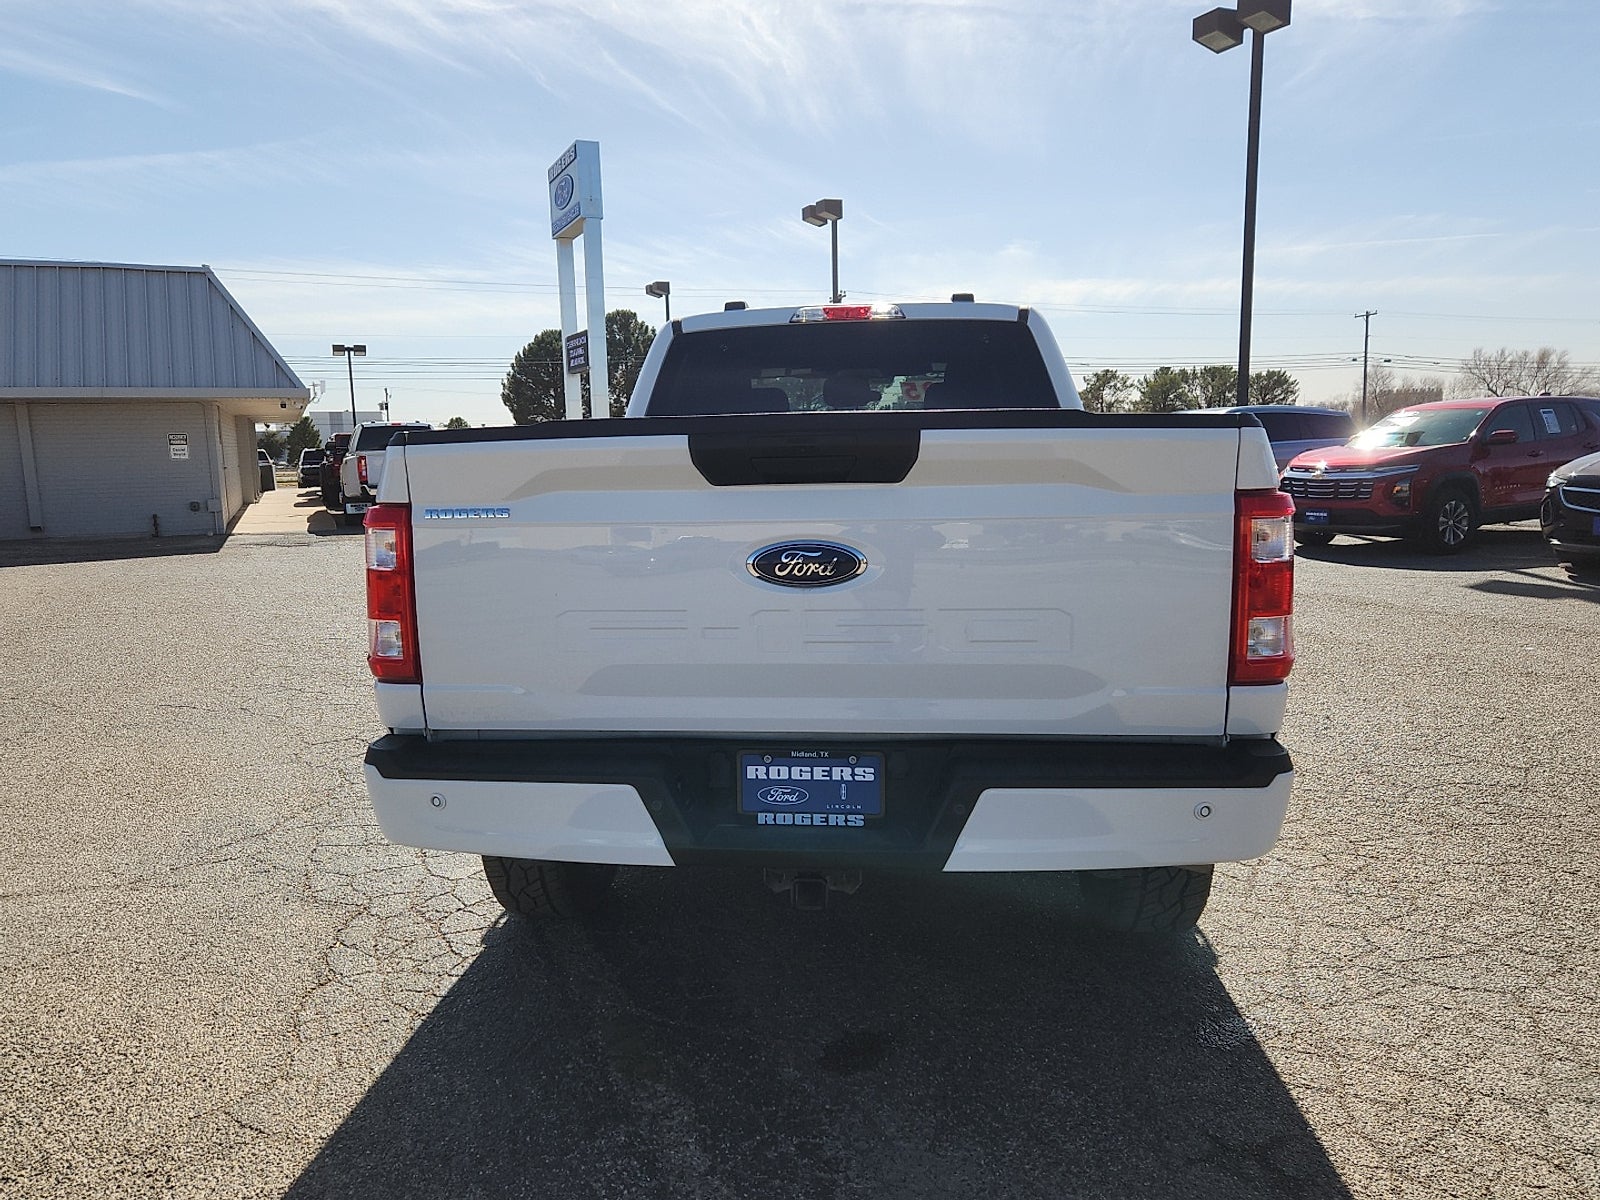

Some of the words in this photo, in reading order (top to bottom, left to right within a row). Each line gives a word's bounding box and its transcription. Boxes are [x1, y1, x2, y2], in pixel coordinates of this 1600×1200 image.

[424, 507, 510, 519] ROGERS
[774, 550, 837, 577] Ford
[746, 765, 875, 781] ROGERS
[767, 788, 799, 802] Ford
[757, 812, 865, 826] ROGERS
